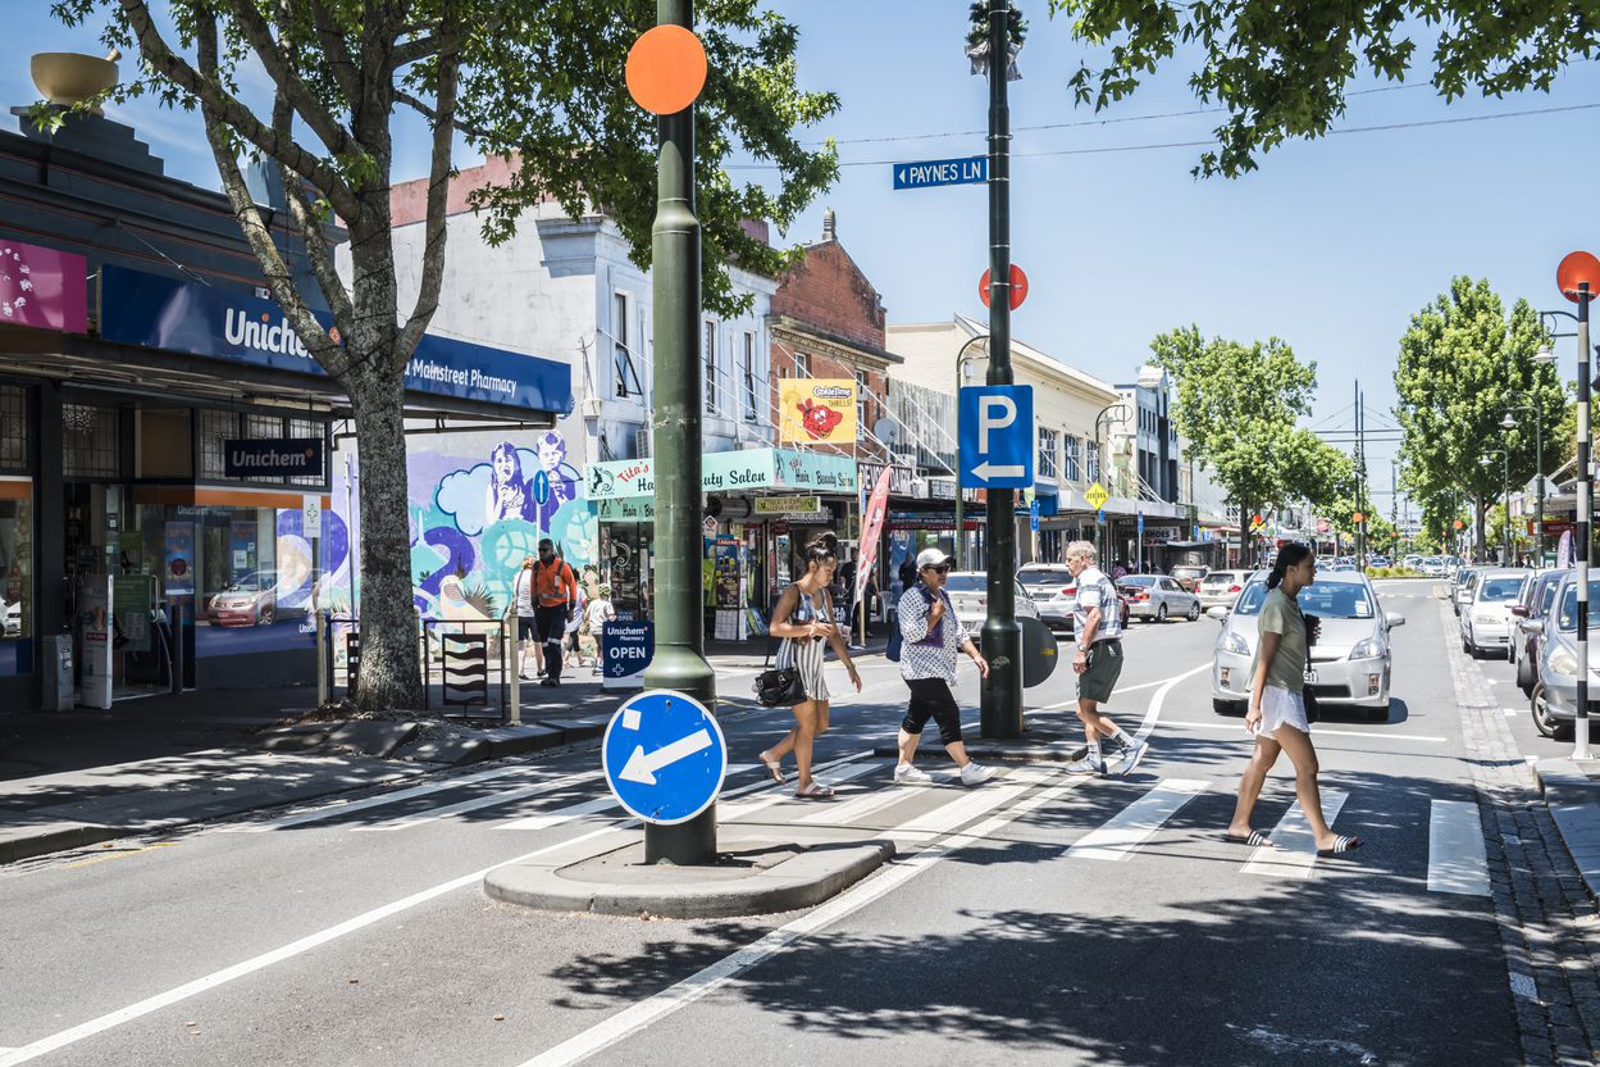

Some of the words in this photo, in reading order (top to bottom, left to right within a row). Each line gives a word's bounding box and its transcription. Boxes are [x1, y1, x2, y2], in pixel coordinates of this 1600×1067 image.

[910, 163, 958, 184] PAYNES
[963, 161, 981, 179] LN
[225, 307, 314, 359] Uniche
[412, 359, 468, 386] Mainstreet
[470, 369, 517, 398] Pharmacy
[979, 395, 1017, 454] P
[232, 449, 307, 467] Unichem
[617, 461, 650, 483] Tita's
[637, 477, 655, 492] Ha
[729, 467, 766, 485] Salon
[607, 627, 645, 635] Unichem
[610, 647, 646, 659] OPEN
